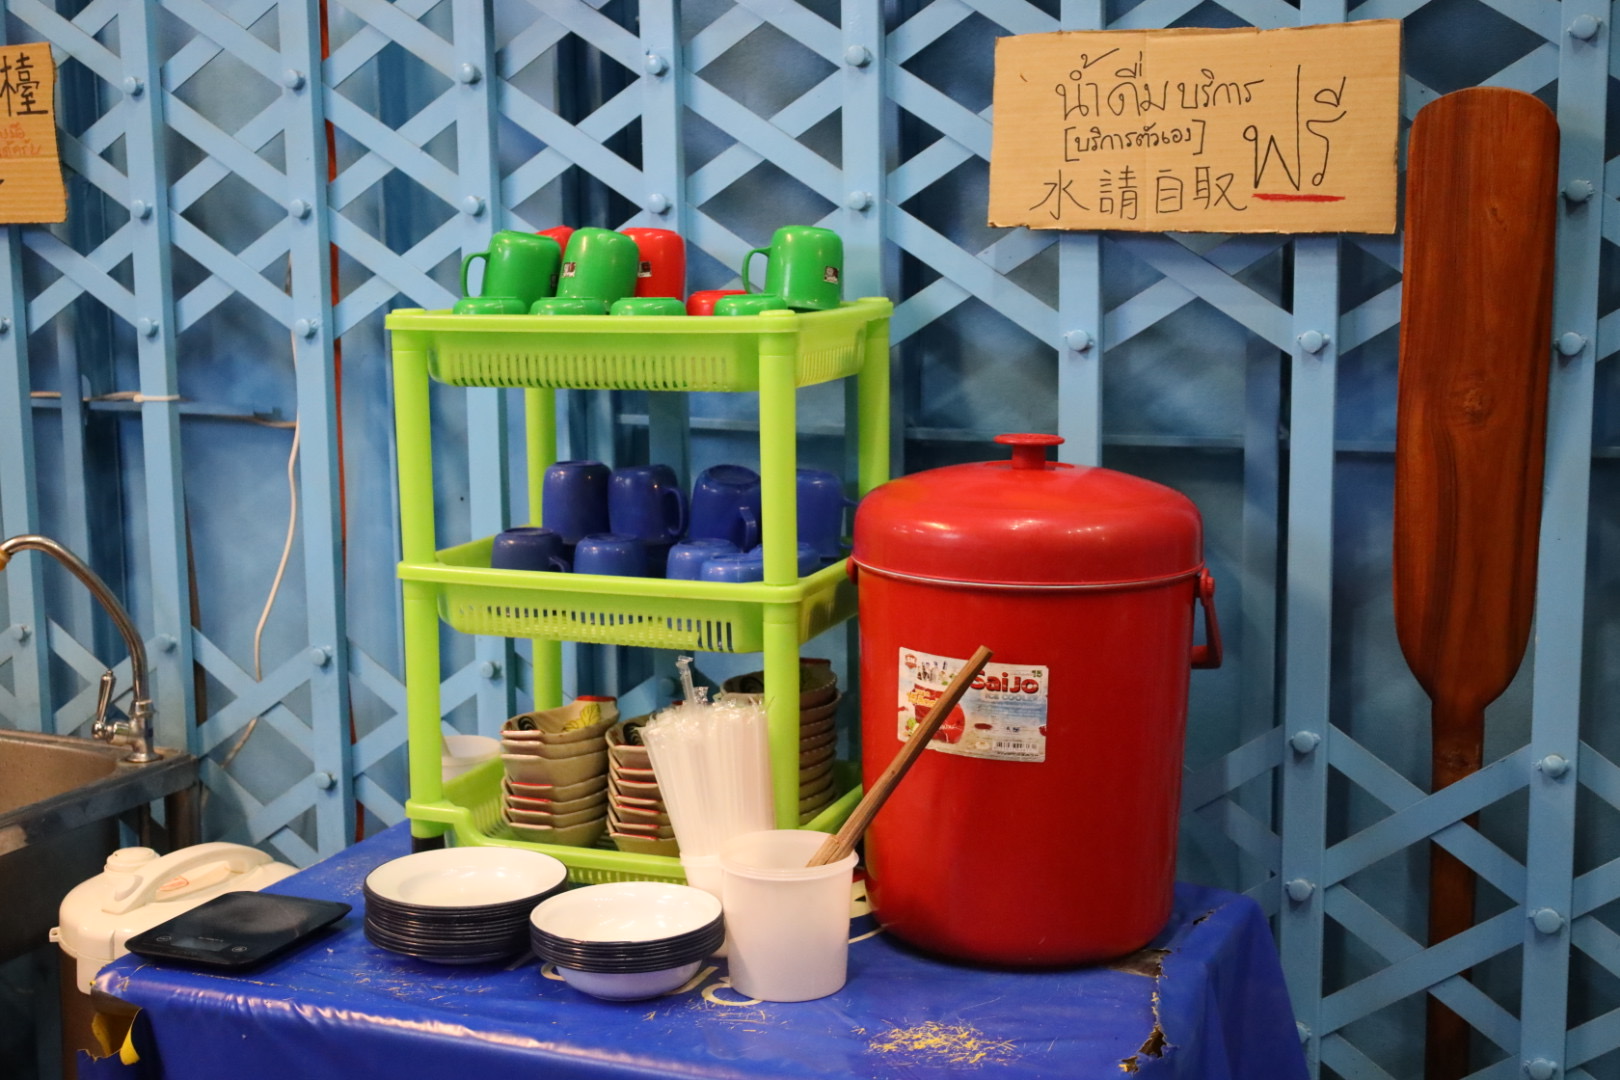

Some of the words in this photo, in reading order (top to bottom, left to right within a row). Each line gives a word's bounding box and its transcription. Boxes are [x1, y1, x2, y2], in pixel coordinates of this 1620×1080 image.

[1243, 64, 1347, 191] ฟรี
[1029, 165, 1248, 220] 水請自取
